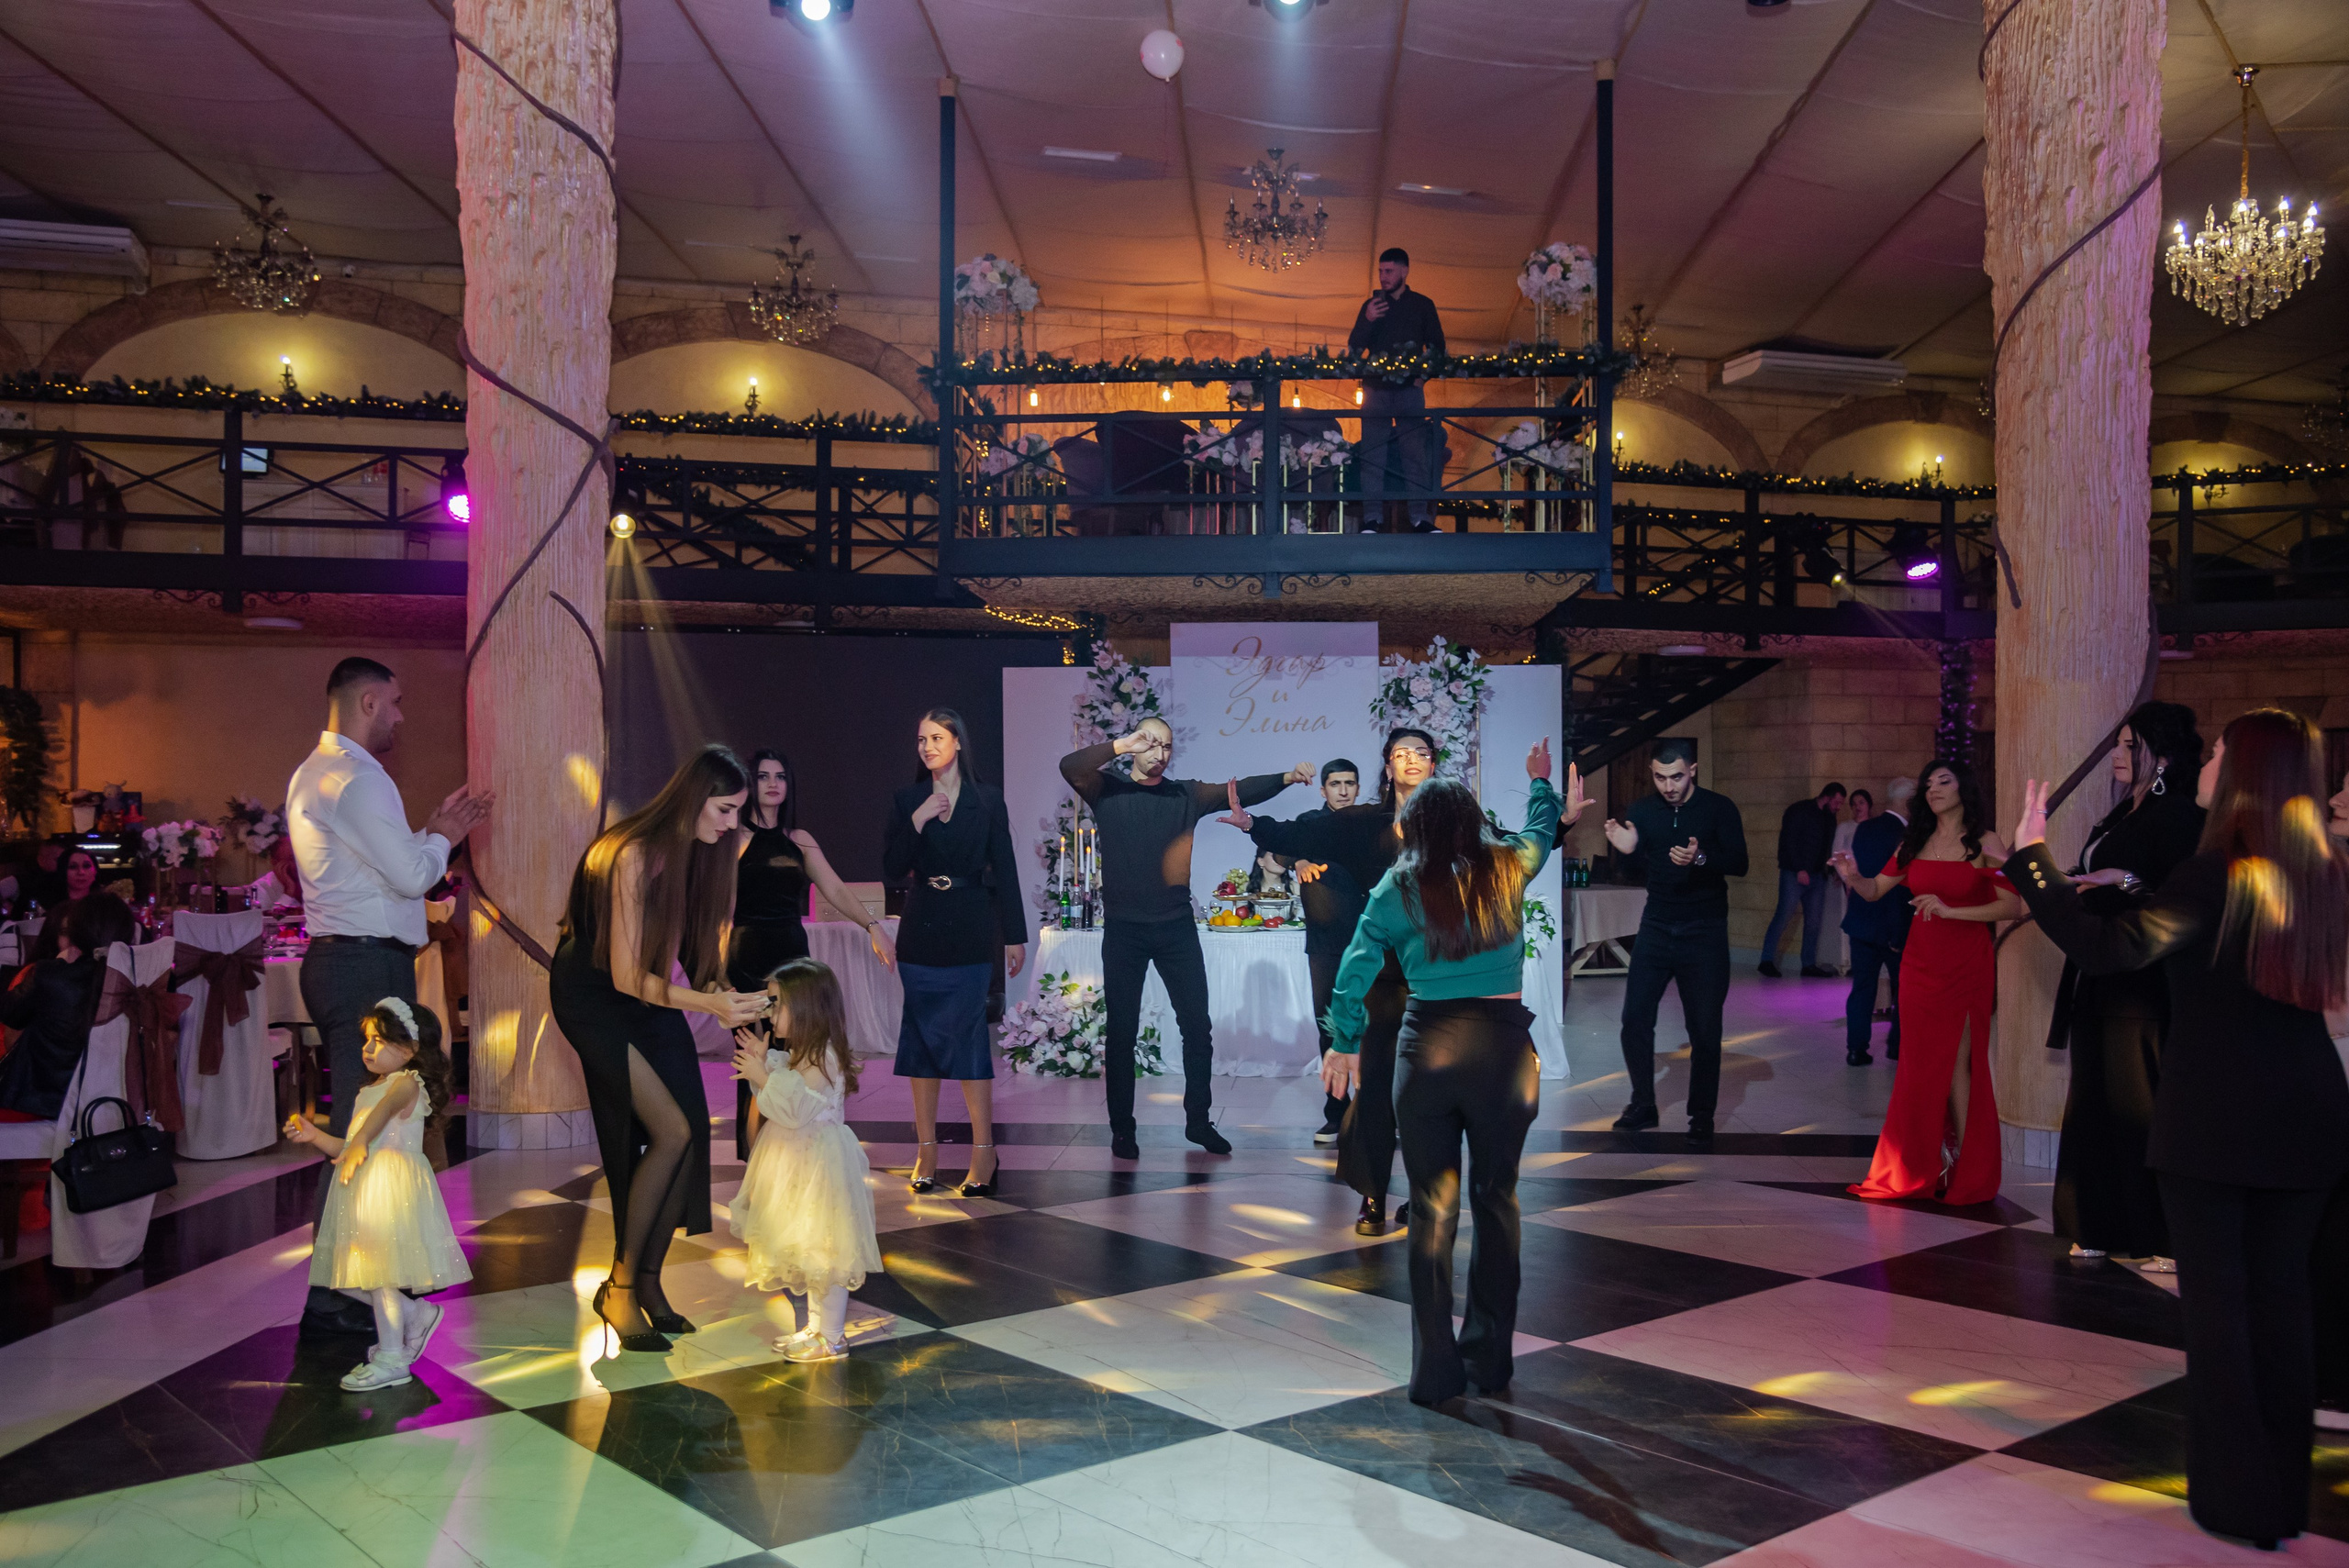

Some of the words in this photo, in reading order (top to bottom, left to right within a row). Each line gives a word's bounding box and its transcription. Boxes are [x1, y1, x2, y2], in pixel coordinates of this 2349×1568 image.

[1226, 636, 1325, 698] Эдгар
[1272, 688, 1289, 703] и
[1219, 696, 1334, 737] Элина
